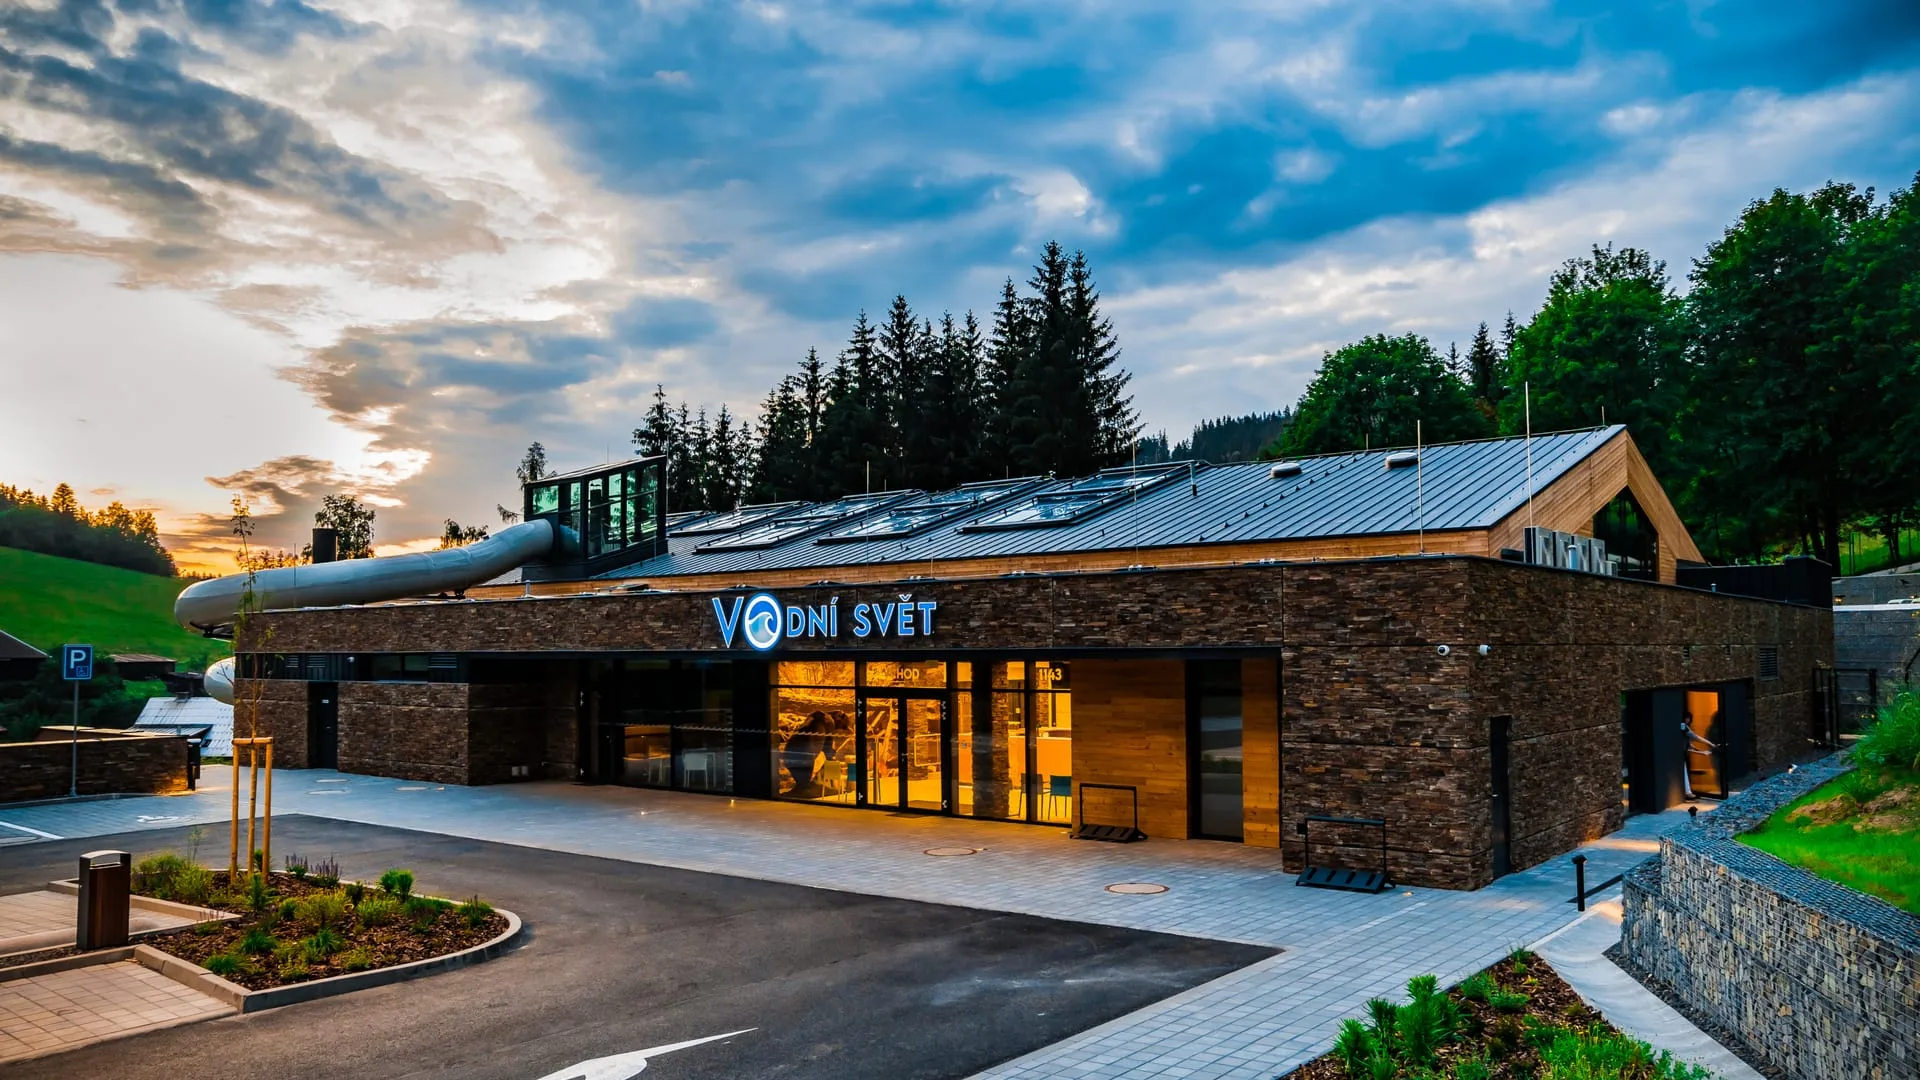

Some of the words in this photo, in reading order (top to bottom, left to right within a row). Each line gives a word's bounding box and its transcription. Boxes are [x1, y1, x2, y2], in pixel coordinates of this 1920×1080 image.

[711, 594, 838, 649] VODNÍ
[853, 594, 937, 637] SVĚT
[70, 649, 87, 669] P
[1038, 668, 1062, 681] 1143
